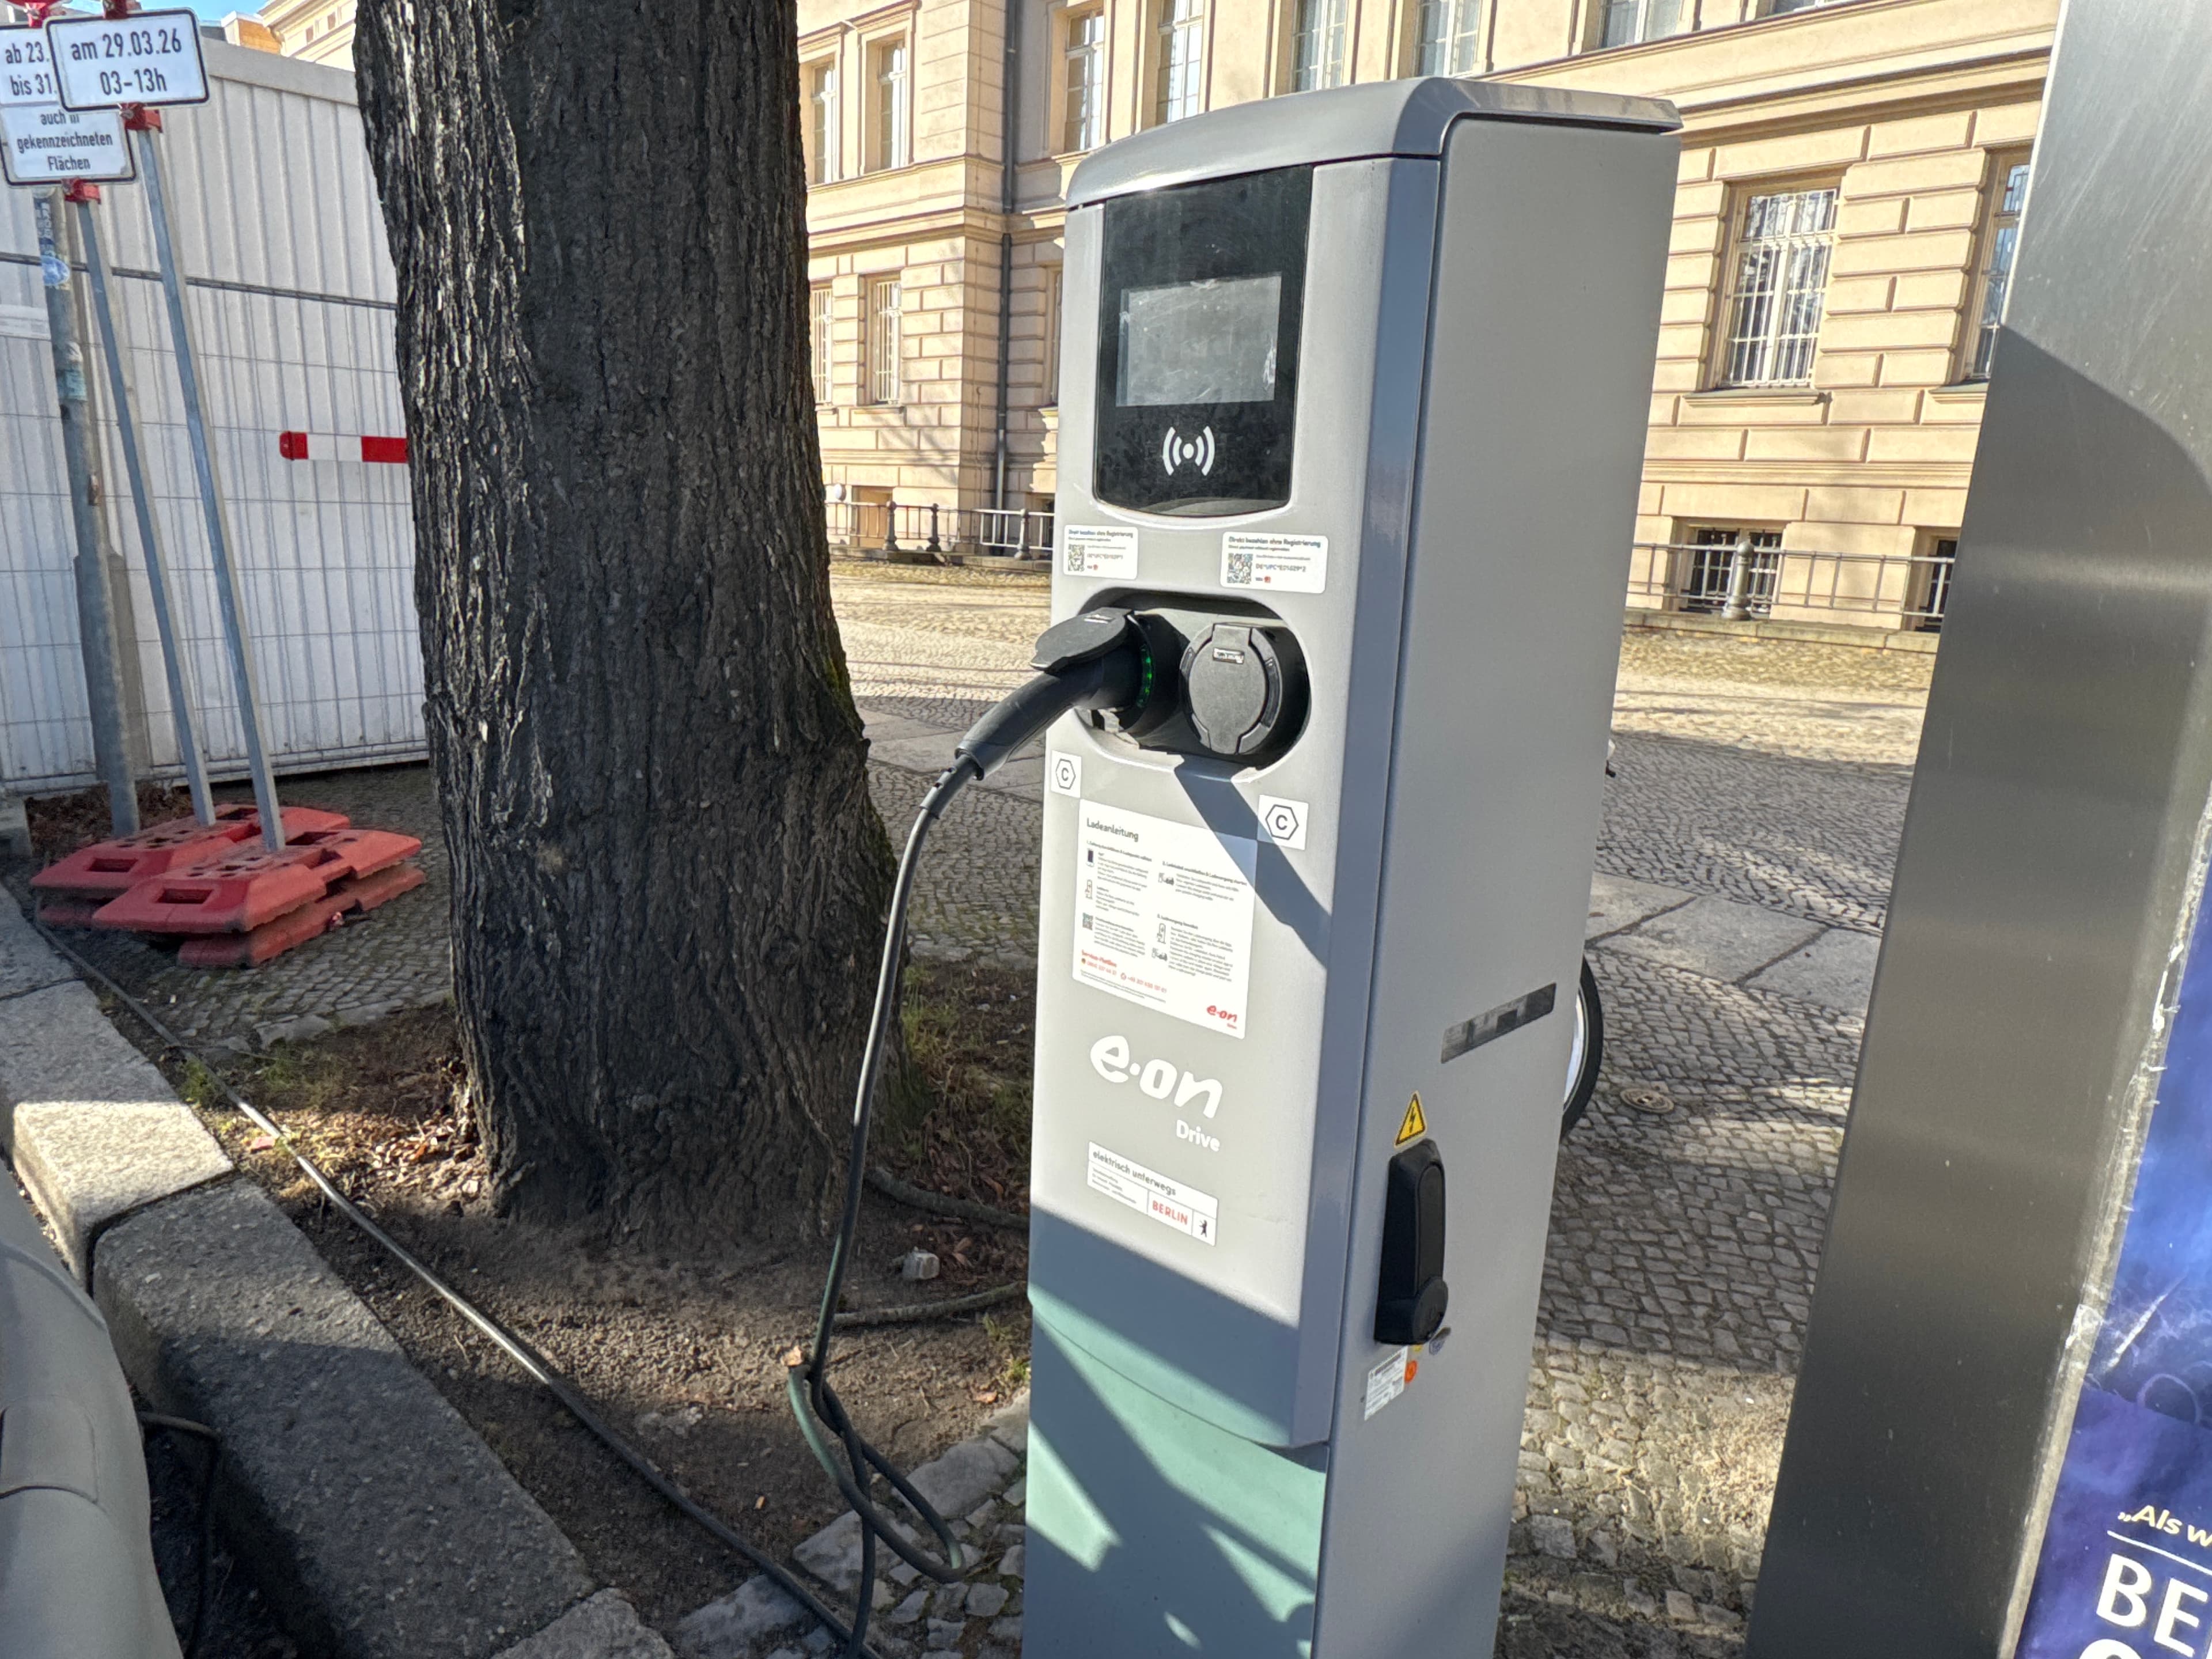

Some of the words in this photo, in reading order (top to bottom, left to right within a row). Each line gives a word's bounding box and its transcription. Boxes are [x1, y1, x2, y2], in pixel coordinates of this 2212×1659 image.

[5, 43, 22, 64] ab
[70, 41, 98, 61] am
[103, 28, 182, 58] 29.03.26
[10, 74, 32, 96] bis
[100, 68, 168, 96] 03-13h
[40, 109, 66, 125] auch
[17, 132, 113, 154] gekennzeichneten
[47, 156, 90, 171] Flächen
[1061, 767, 1069, 781] C
[1086, 817, 1139, 842] Ladeanleitung
[1275, 814, 1288, 831] C
[1176, 1119, 1221, 1152] Drive
[1093, 1151, 1130, 1175] elektrisch
[1132, 1170, 1176, 1196] unterwegs
[1153, 1200, 1188, 1225] BERLIN
[2096, 1552, 2212, 1659] BE
